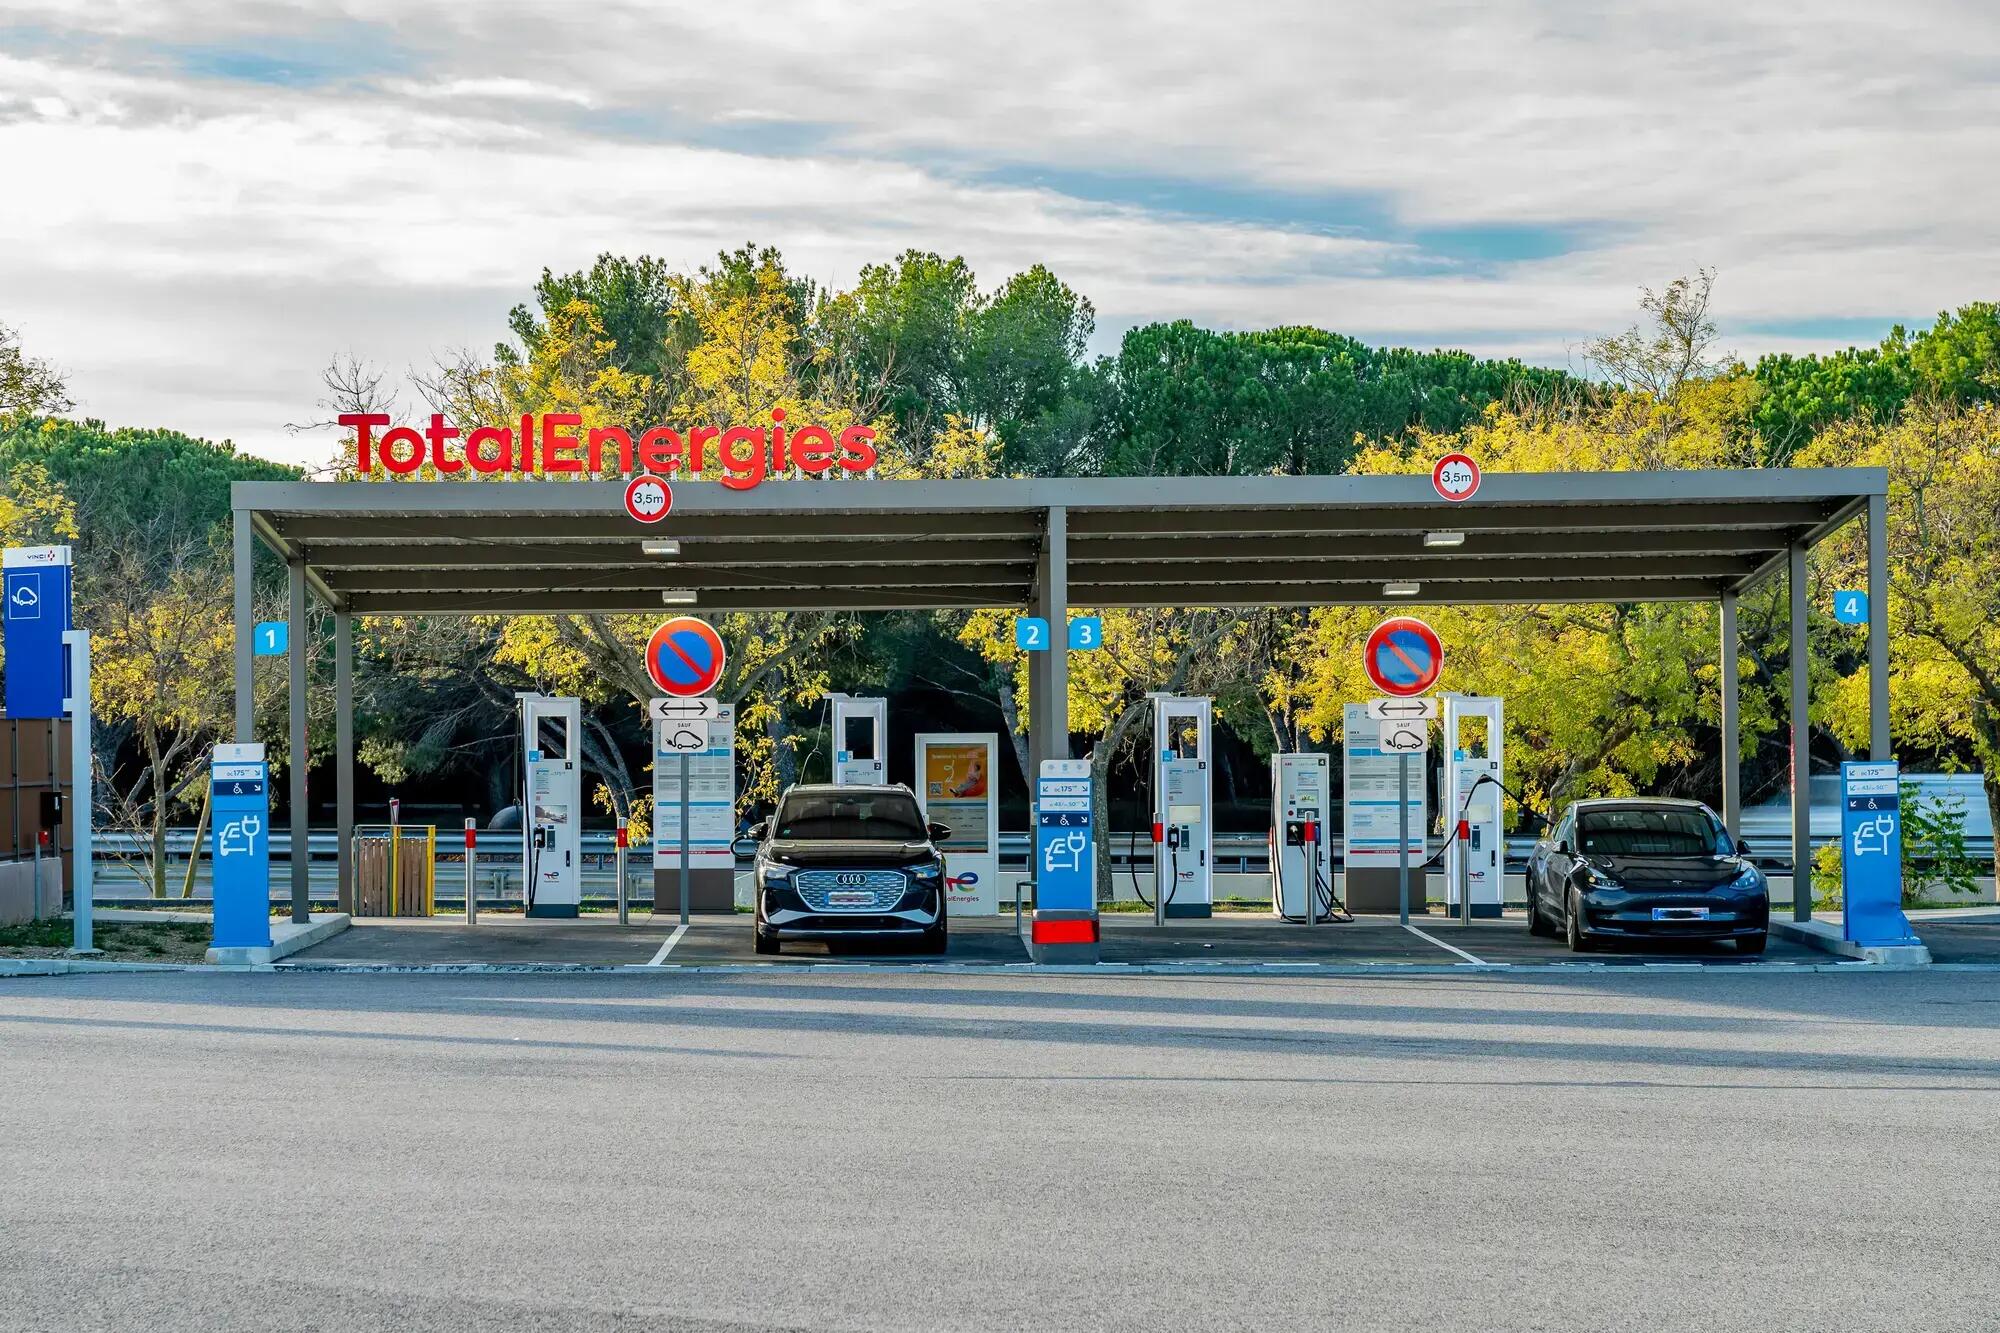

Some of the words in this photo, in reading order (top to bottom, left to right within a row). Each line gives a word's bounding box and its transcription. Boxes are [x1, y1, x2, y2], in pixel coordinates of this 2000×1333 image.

[338, 407, 877, 490] TotalEnergies
[1442, 471, 1471, 484] 3,5m
[634, 492, 664, 507] 3,5m
[1844, 597, 1859, 617] 4
[265, 629, 275, 648] 1
[1026, 625, 1040, 645] 2
[1079, 624, 1092, 644] 3
